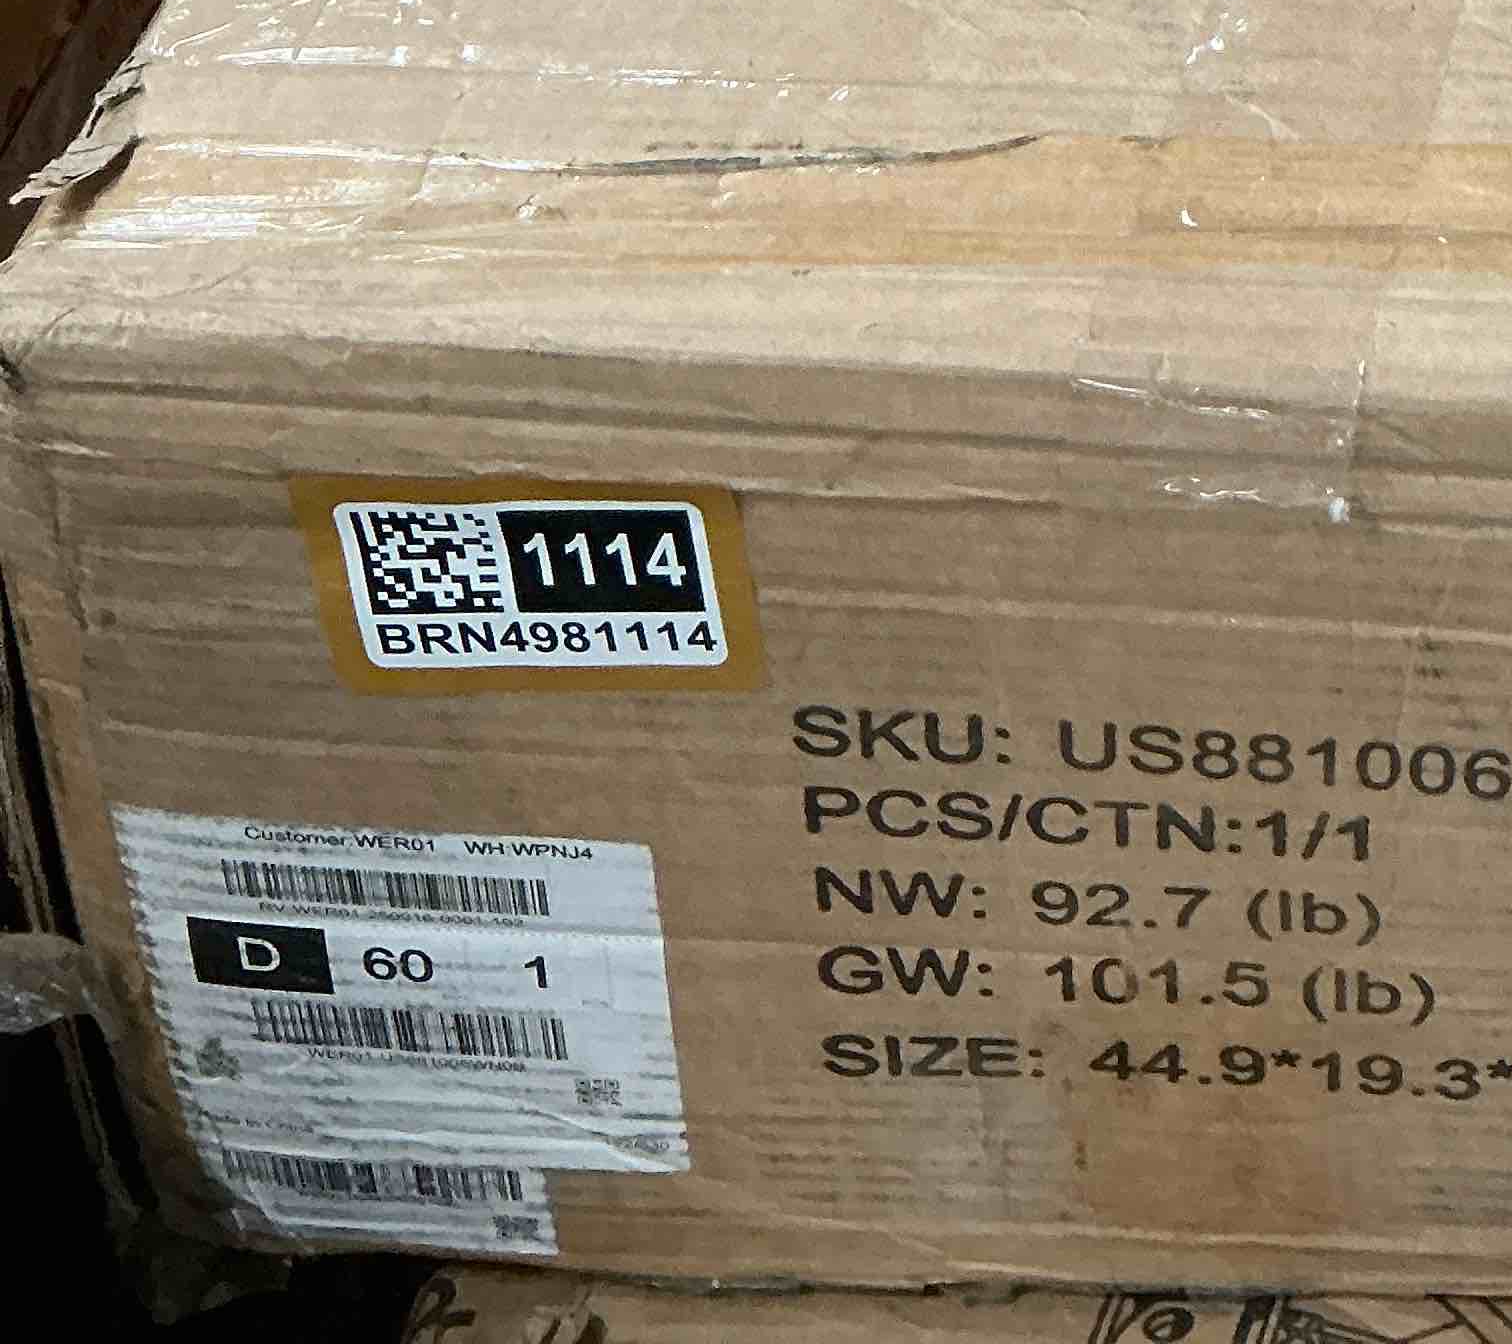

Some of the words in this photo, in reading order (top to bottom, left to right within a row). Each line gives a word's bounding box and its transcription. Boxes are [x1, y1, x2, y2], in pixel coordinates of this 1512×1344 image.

[522, 532, 688, 587] 1114
[376, 620, 718, 656] BRN4981114
[793, 705, 1013, 766] SKU:
[802, 784, 1374, 862] PCS/CTN:1/1
[813, 867, 988, 920] NW:
[1030, 880, 1211, 932] 92.7
[1246, 886, 1381, 946] (lb)
[236, 936, 281, 972] D
[362, 947, 435, 983] 60
[523, 955, 550, 989] 1
[817, 946, 995, 999] GW:
[1044, 957, 1270, 1010] 101.5
[1302, 965, 1437, 1027] (lb)
[823, 1034, 1044, 1079] SIZE:
